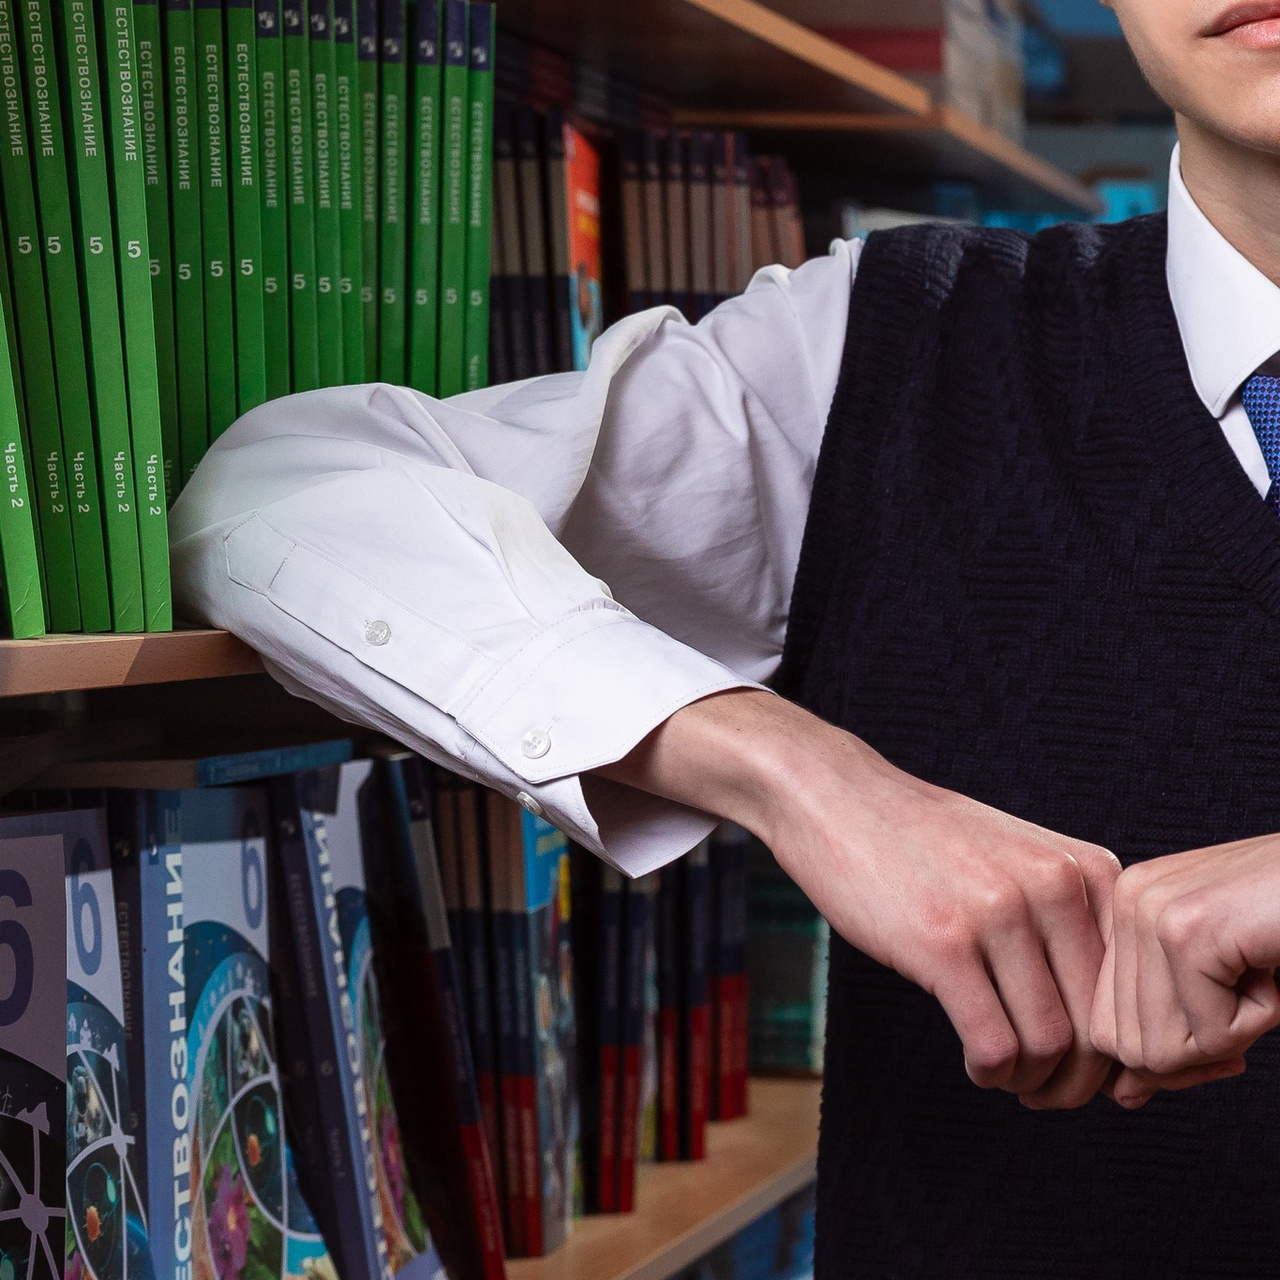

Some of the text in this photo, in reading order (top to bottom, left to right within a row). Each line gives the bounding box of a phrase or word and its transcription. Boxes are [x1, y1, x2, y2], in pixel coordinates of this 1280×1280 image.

[0, 0, 24, 157] ЕСТЕСТВОЗНАНИЕ
[28, 0, 54, 157] ЕСТЕСТВОЗНАНИЕ
[72, 1, 97, 158] ЕСТЕСТВОЗНАНИЕ
[115, 7, 137, 162] ЕСТЕСТВОЗНАНИЕ
[140, 41, 158, 186] ЕСТЕСТВОЗНАНИЕ
[174, 46, 190, 190] ЕСТЕСТВОЗНАНИЕ
[205, 44, 222, 188] ЕСТЕСТВОЗНАНИЕ
[237, 44, 253, 187] ЕСТЕСТВОЗНАНИЕ
[263, 71, 277, 209] ЕСТЕСТВОЗНАНИЕ
[289, 69, 305, 206] ЕСТЕСТВОЗНАНИЕ
[315, 73, 331, 209] ЕСТЕСТВОЗНАНИЕ
[338, 75, 353, 210] ЕСТЕСТВОЗНАНИЕ
[18, 236, 33, 255] 5
[47, 236, 61, 255] 5
[89, 236, 104, 255] 5
[127, 240, 142, 259] 5
[149, 259, 161, 276] 5
[178, 263, 191, 280] 5
[210, 260, 224, 277] 5
[240, 259, 253, 276] 5
[265, 277, 278, 293] 5
[293, 274, 306, 290] 5
[318, 277, 331, 293] 5
[340, 277, 353, 293] 5
[362, 287, 374, 303] 5
[384, 288, 396, 304] 5
[416, 289, 428, 306] 5
[446, 288, 457, 305] 5
[470, 290, 482, 307] 5
[4, 442, 24, 509] Часть 2
[47, 451, 64, 514] Часть 2
[73, 451, 90, 514] Часть 2
[113, 451, 130, 514] Часть 2
[145, 454, 162, 516] Часть 2
[242, 806, 263, 929] 6
[70, 837, 102, 977] 6
